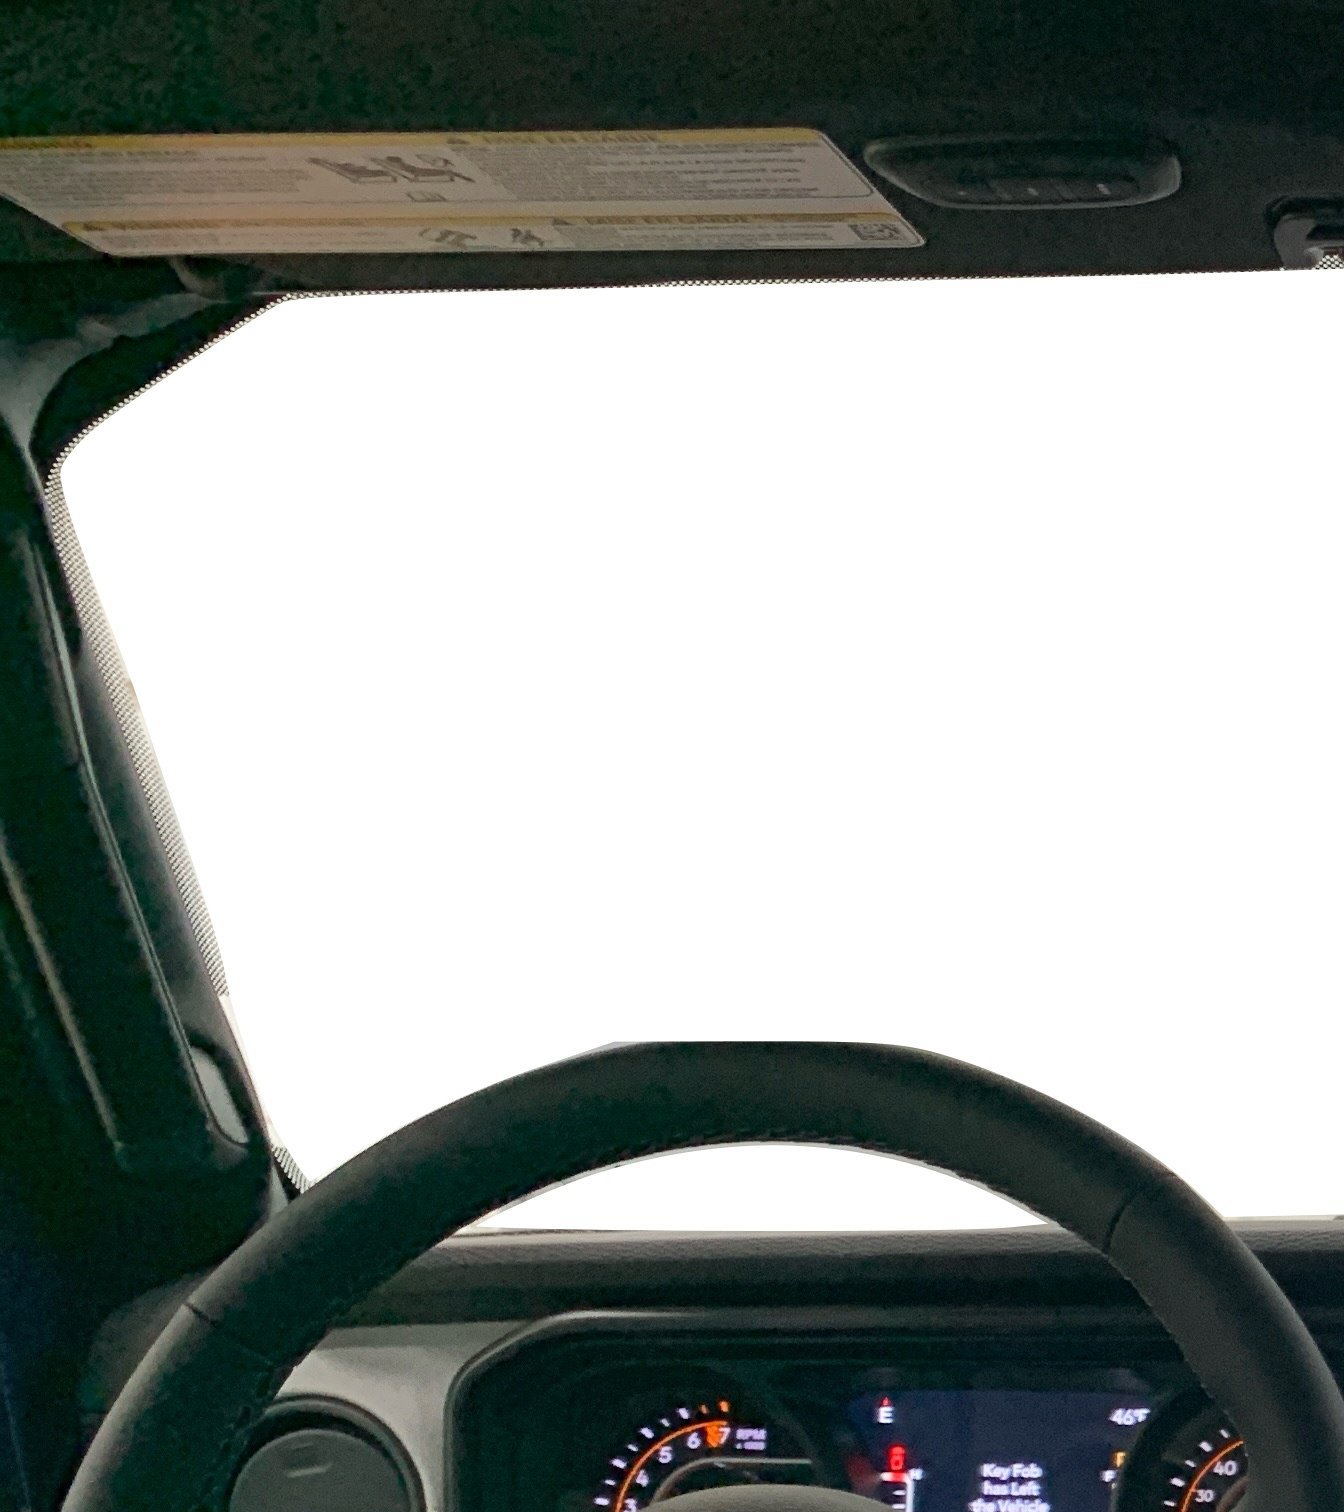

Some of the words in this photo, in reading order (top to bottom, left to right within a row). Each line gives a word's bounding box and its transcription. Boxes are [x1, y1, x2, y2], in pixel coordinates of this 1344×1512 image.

[878, 1406, 894, 1424] E
[686, 1431, 702, 1450] 6
[719, 1426, 732, 1446] 7
[658, 1446, 674, 1465] 5
[981, 1463, 1011, 1480] Key
[1012, 1463, 1043, 1478] Fob
[1213, 1460, 1238, 1476] 40
[634, 1469, 650, 1488] 4
[981, 1480, 1009, 1495] has
[1010, 1480, 1041, 1496] Left
[1194, 1489, 1215, 1503] 30
